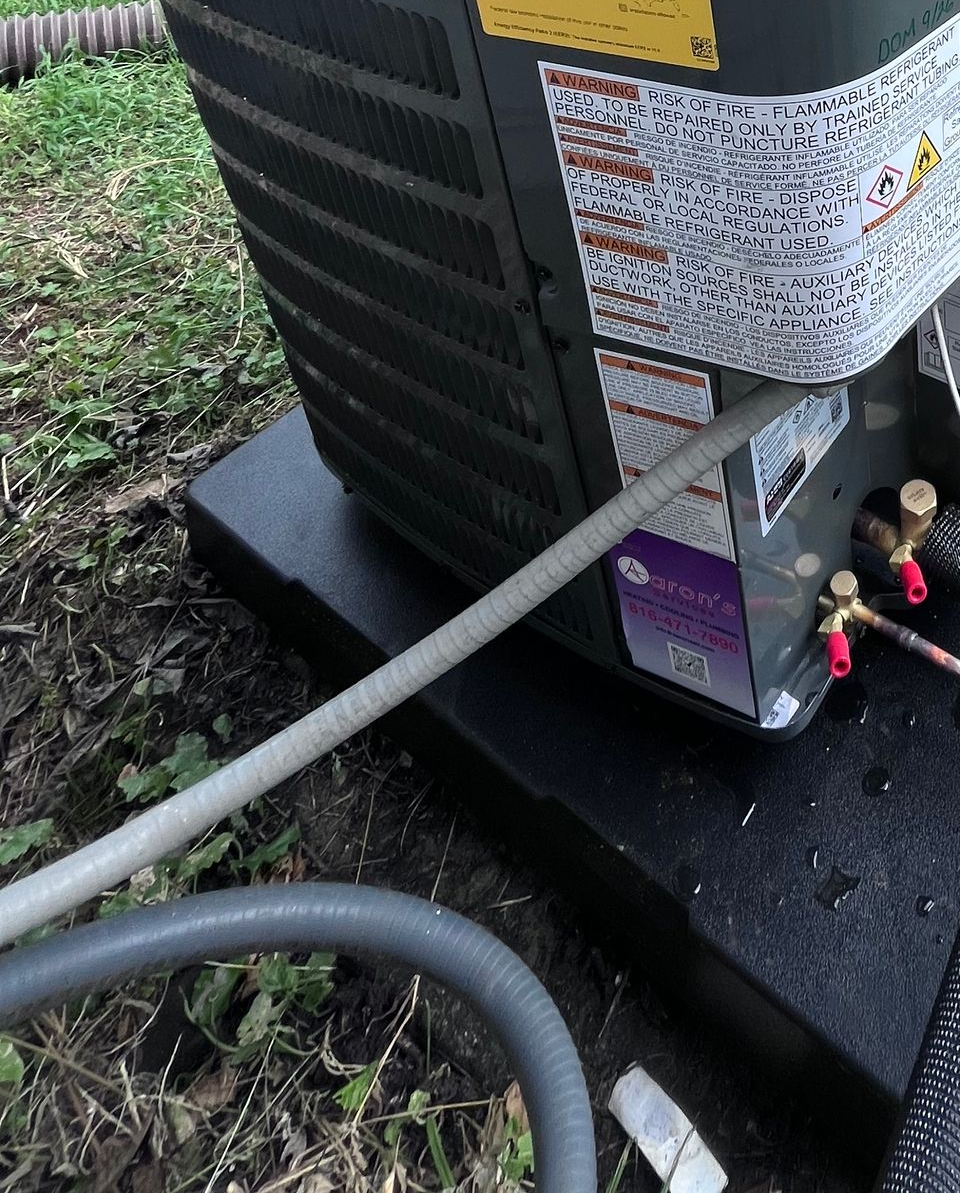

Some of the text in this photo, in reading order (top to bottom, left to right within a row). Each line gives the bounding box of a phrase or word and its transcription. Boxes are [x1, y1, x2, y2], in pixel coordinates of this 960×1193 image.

[878, 18, 915, 63] DOM
[553, 56, 938, 136] USED. TO BE REPAIRED ONLY BY TRAINED SERVICE
[563, 26, 955, 119] WARNING RISK OF FIRE FLAMMABLE REFRIGERANT
[555, 102, 651, 131] PERSONNEL.
[655, 122, 678, 137] DO
[684, 127, 716, 145] NOT
[721, 135, 819, 151] PUNCTURE
[825, 82, 920, 145] REFRIGERANT
[568, 168, 586, 180] OF
[591, 173, 669, 199] PROPERLY
[674, 191, 689, 204] IN
[694, 197, 810, 220] ACCORDANCE
[816, 193, 859, 217] WITH
[580, 156, 857, 205] WARNING RISK OF FIRE DISPOSE
[571, 182, 848, 235] FEDERAL OR LOCAL REGULATIONS.
[574, 197, 661, 226] FLAMMABLE
[665, 217, 774, 250] REFRIGERANT
[780, 235, 833, 251] USED.
[587, 247, 605, 261] BE
[609, 253, 672, 277] IGNITION
[676, 269, 748, 297] SOURCES
[753, 289, 805, 302] SHALL
[811, 285, 845, 302] NOT
[851, 274, 870, 291] BE
[874, 222, 930, 279] INSTALLED
[932, 212, 941, 225] IN
[596, 237, 666, 261] WARNING
[676, 256, 710, 274] RISK
[714, 266, 735, 278] OF
[739, 272, 775, 288] FIRE
[791, 257, 875, 289] AUXILIARY
[878, 215, 923, 263] DEVICES
[925, 184, 957, 217] WHICH
[590, 260, 676, 291] DUCTWORK,
[680, 282, 732, 305] OTHER
[734, 295, 776, 315] THAN
[782, 289, 866, 316] AUXILIARY
[870, 249, 916, 295] DEVICES
[920, 214, 952, 249] LISTED
[592, 274, 620, 290] USE
[623, 281, 660, 299] WITH
[664, 292, 692, 307] THE
[697, 301, 764, 327] SPECIFIC
[769, 307, 865, 331] APPLIANCE.
[870, 287, 892, 311] SEE
[640, 365, 682, 380] WARNING
[628, 602, 739, 654] 816-471-7890
